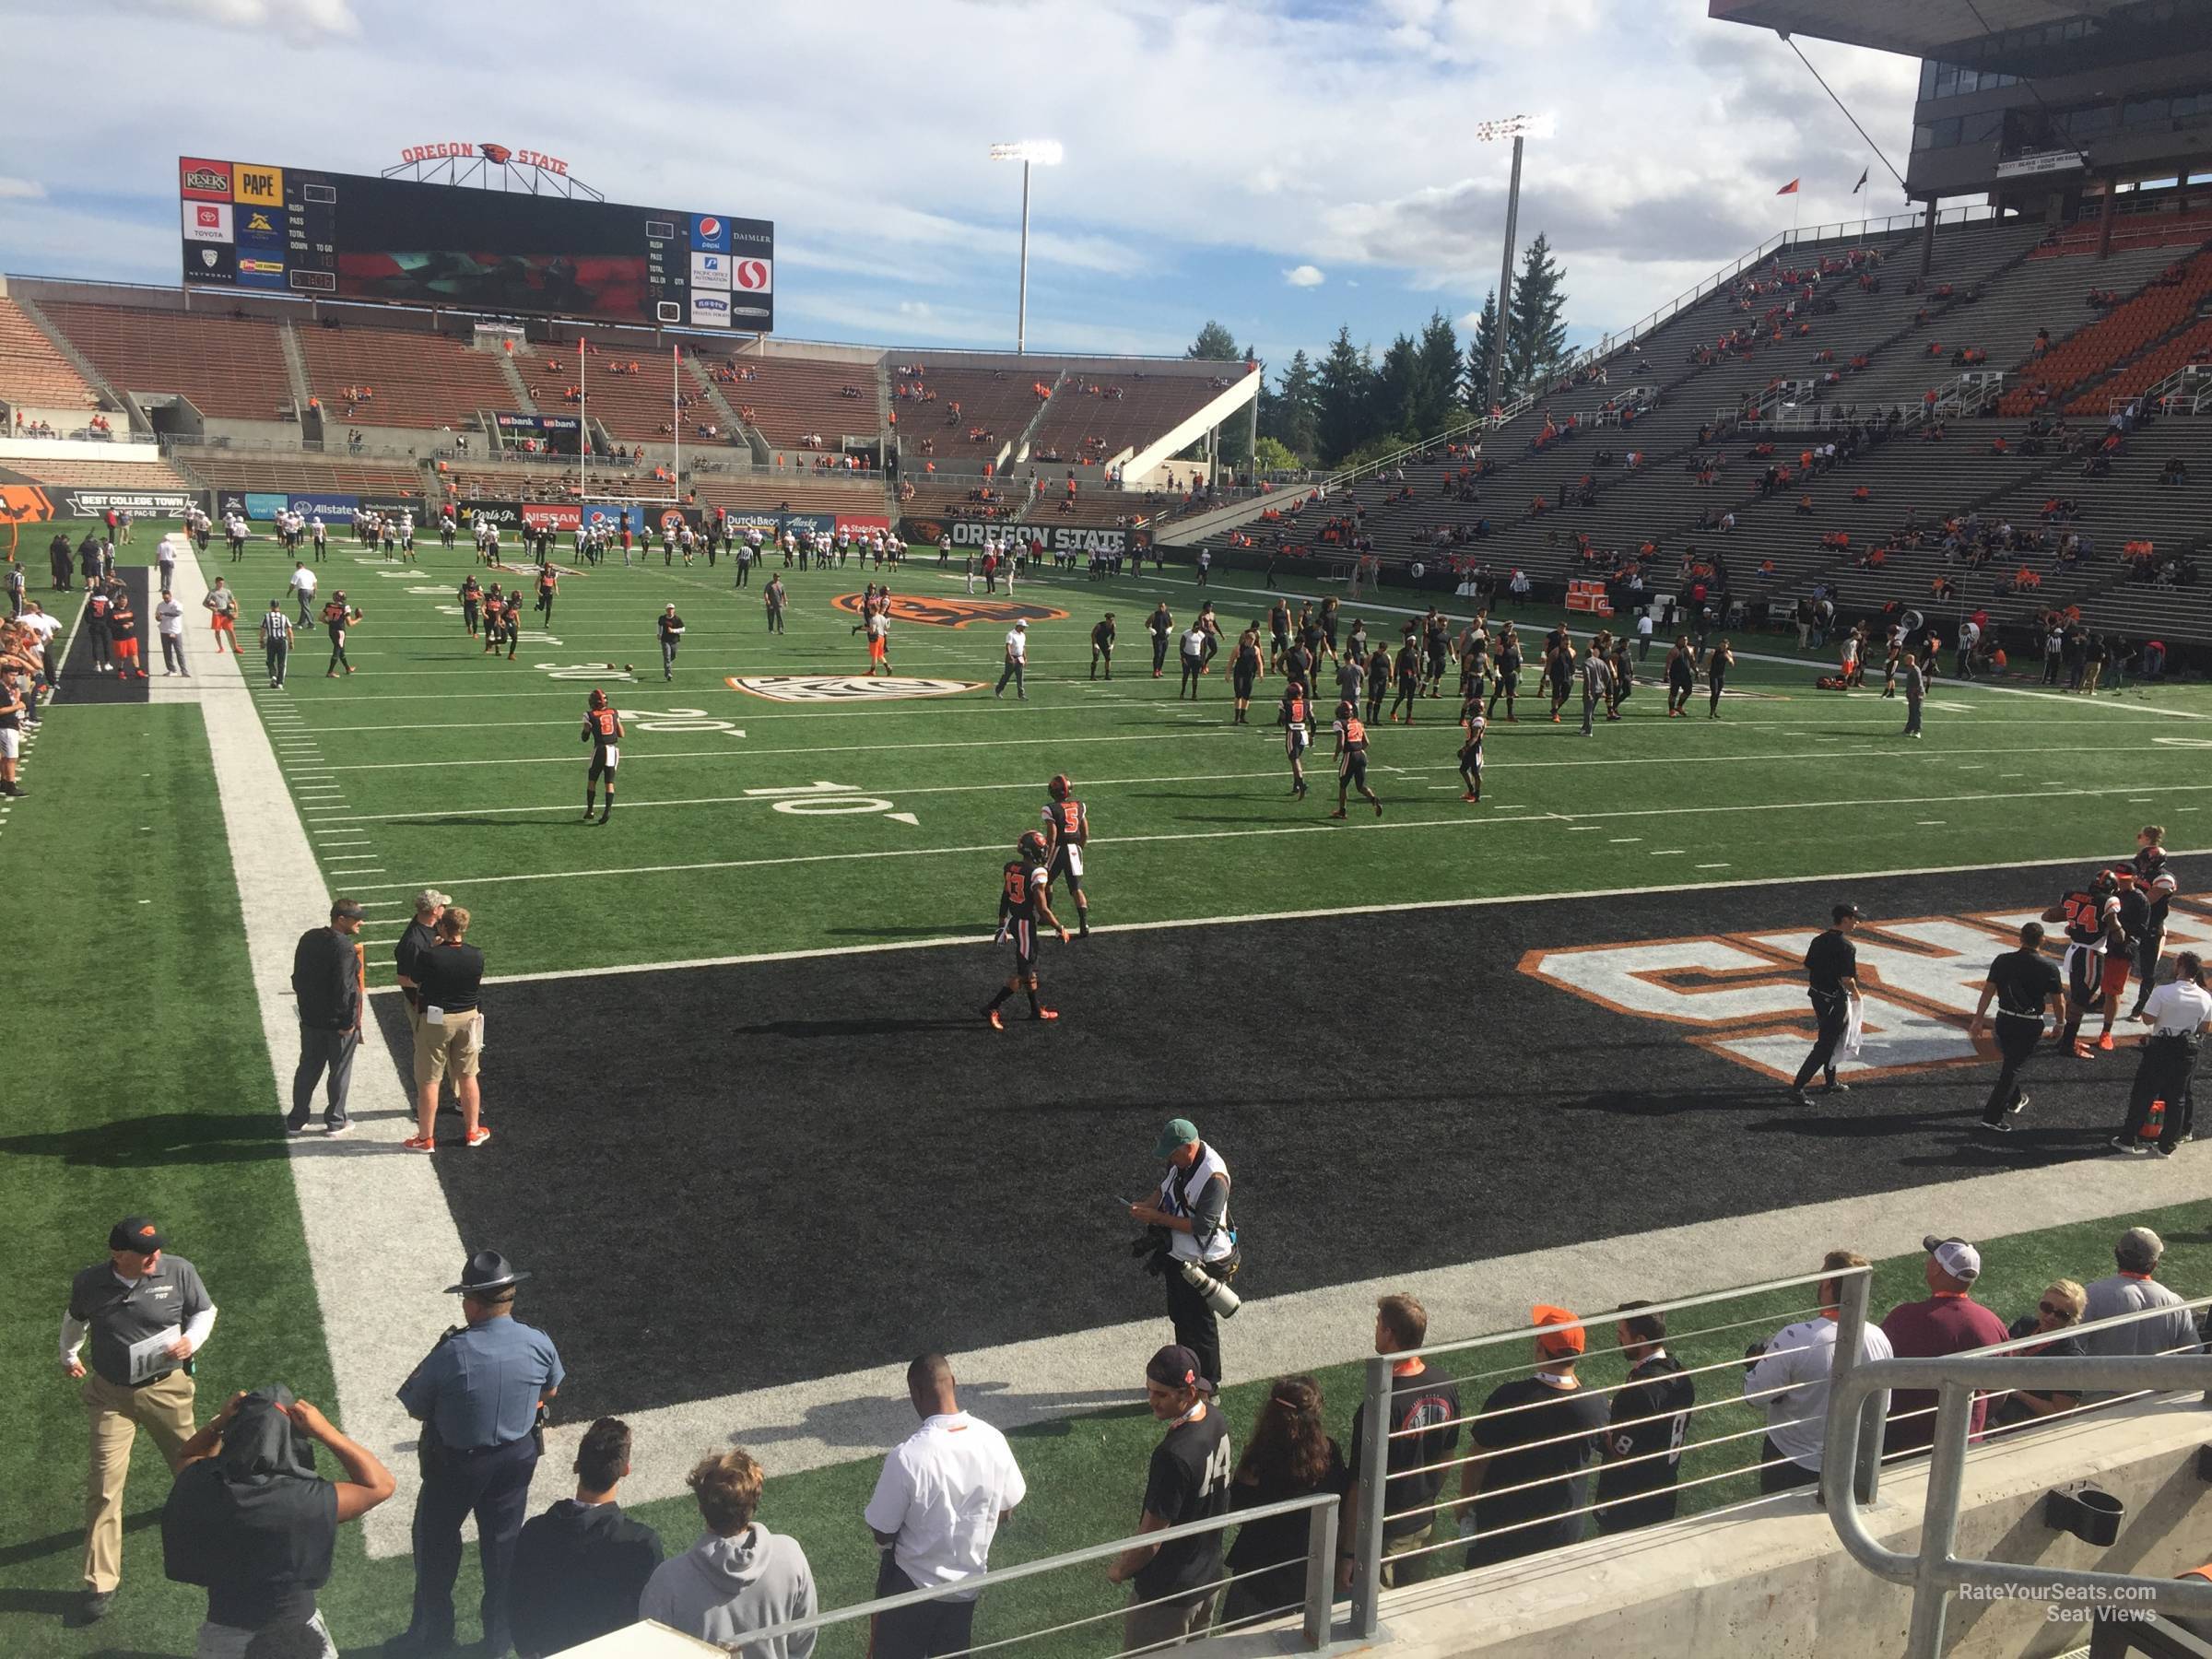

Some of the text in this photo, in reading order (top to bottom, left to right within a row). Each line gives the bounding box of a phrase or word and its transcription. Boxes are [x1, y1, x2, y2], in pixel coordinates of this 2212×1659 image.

[402, 142, 569, 176] OREGON STATE
[288, 204, 304, 212] RUSH
[289, 217, 304, 226] PASS
[194, 229, 223, 238] TOYOTA
[288, 229, 306, 239] TOTAL
[733, 232, 771, 243] DAIMLER
[290, 241, 308, 251] DOWN
[650, 253, 663, 261] PASS
[650, 265, 664, 274] TOTAL
[82, 495, 183, 506] BEST COLLEGE TOWN
[313, 503, 353, 514] Allstate
[365, 503, 397, 512] Washington
[471, 508, 500, 522] Carl's
[525, 512, 580, 523] NISSAN
[727, 514, 757, 525] DUTCH
[786, 516, 818, 528] Alaska
[953, 523, 1126, 550] OREGON STATE
[618, 707, 736, 732] 20
[742, 780, 894, 815] 10
[1064, 807, 1078, 833] 5
[2063, 899, 2099, 934] 24
[1668, 1412, 1688, 1465] 8
[1614, 1434, 1633, 1455] 8
